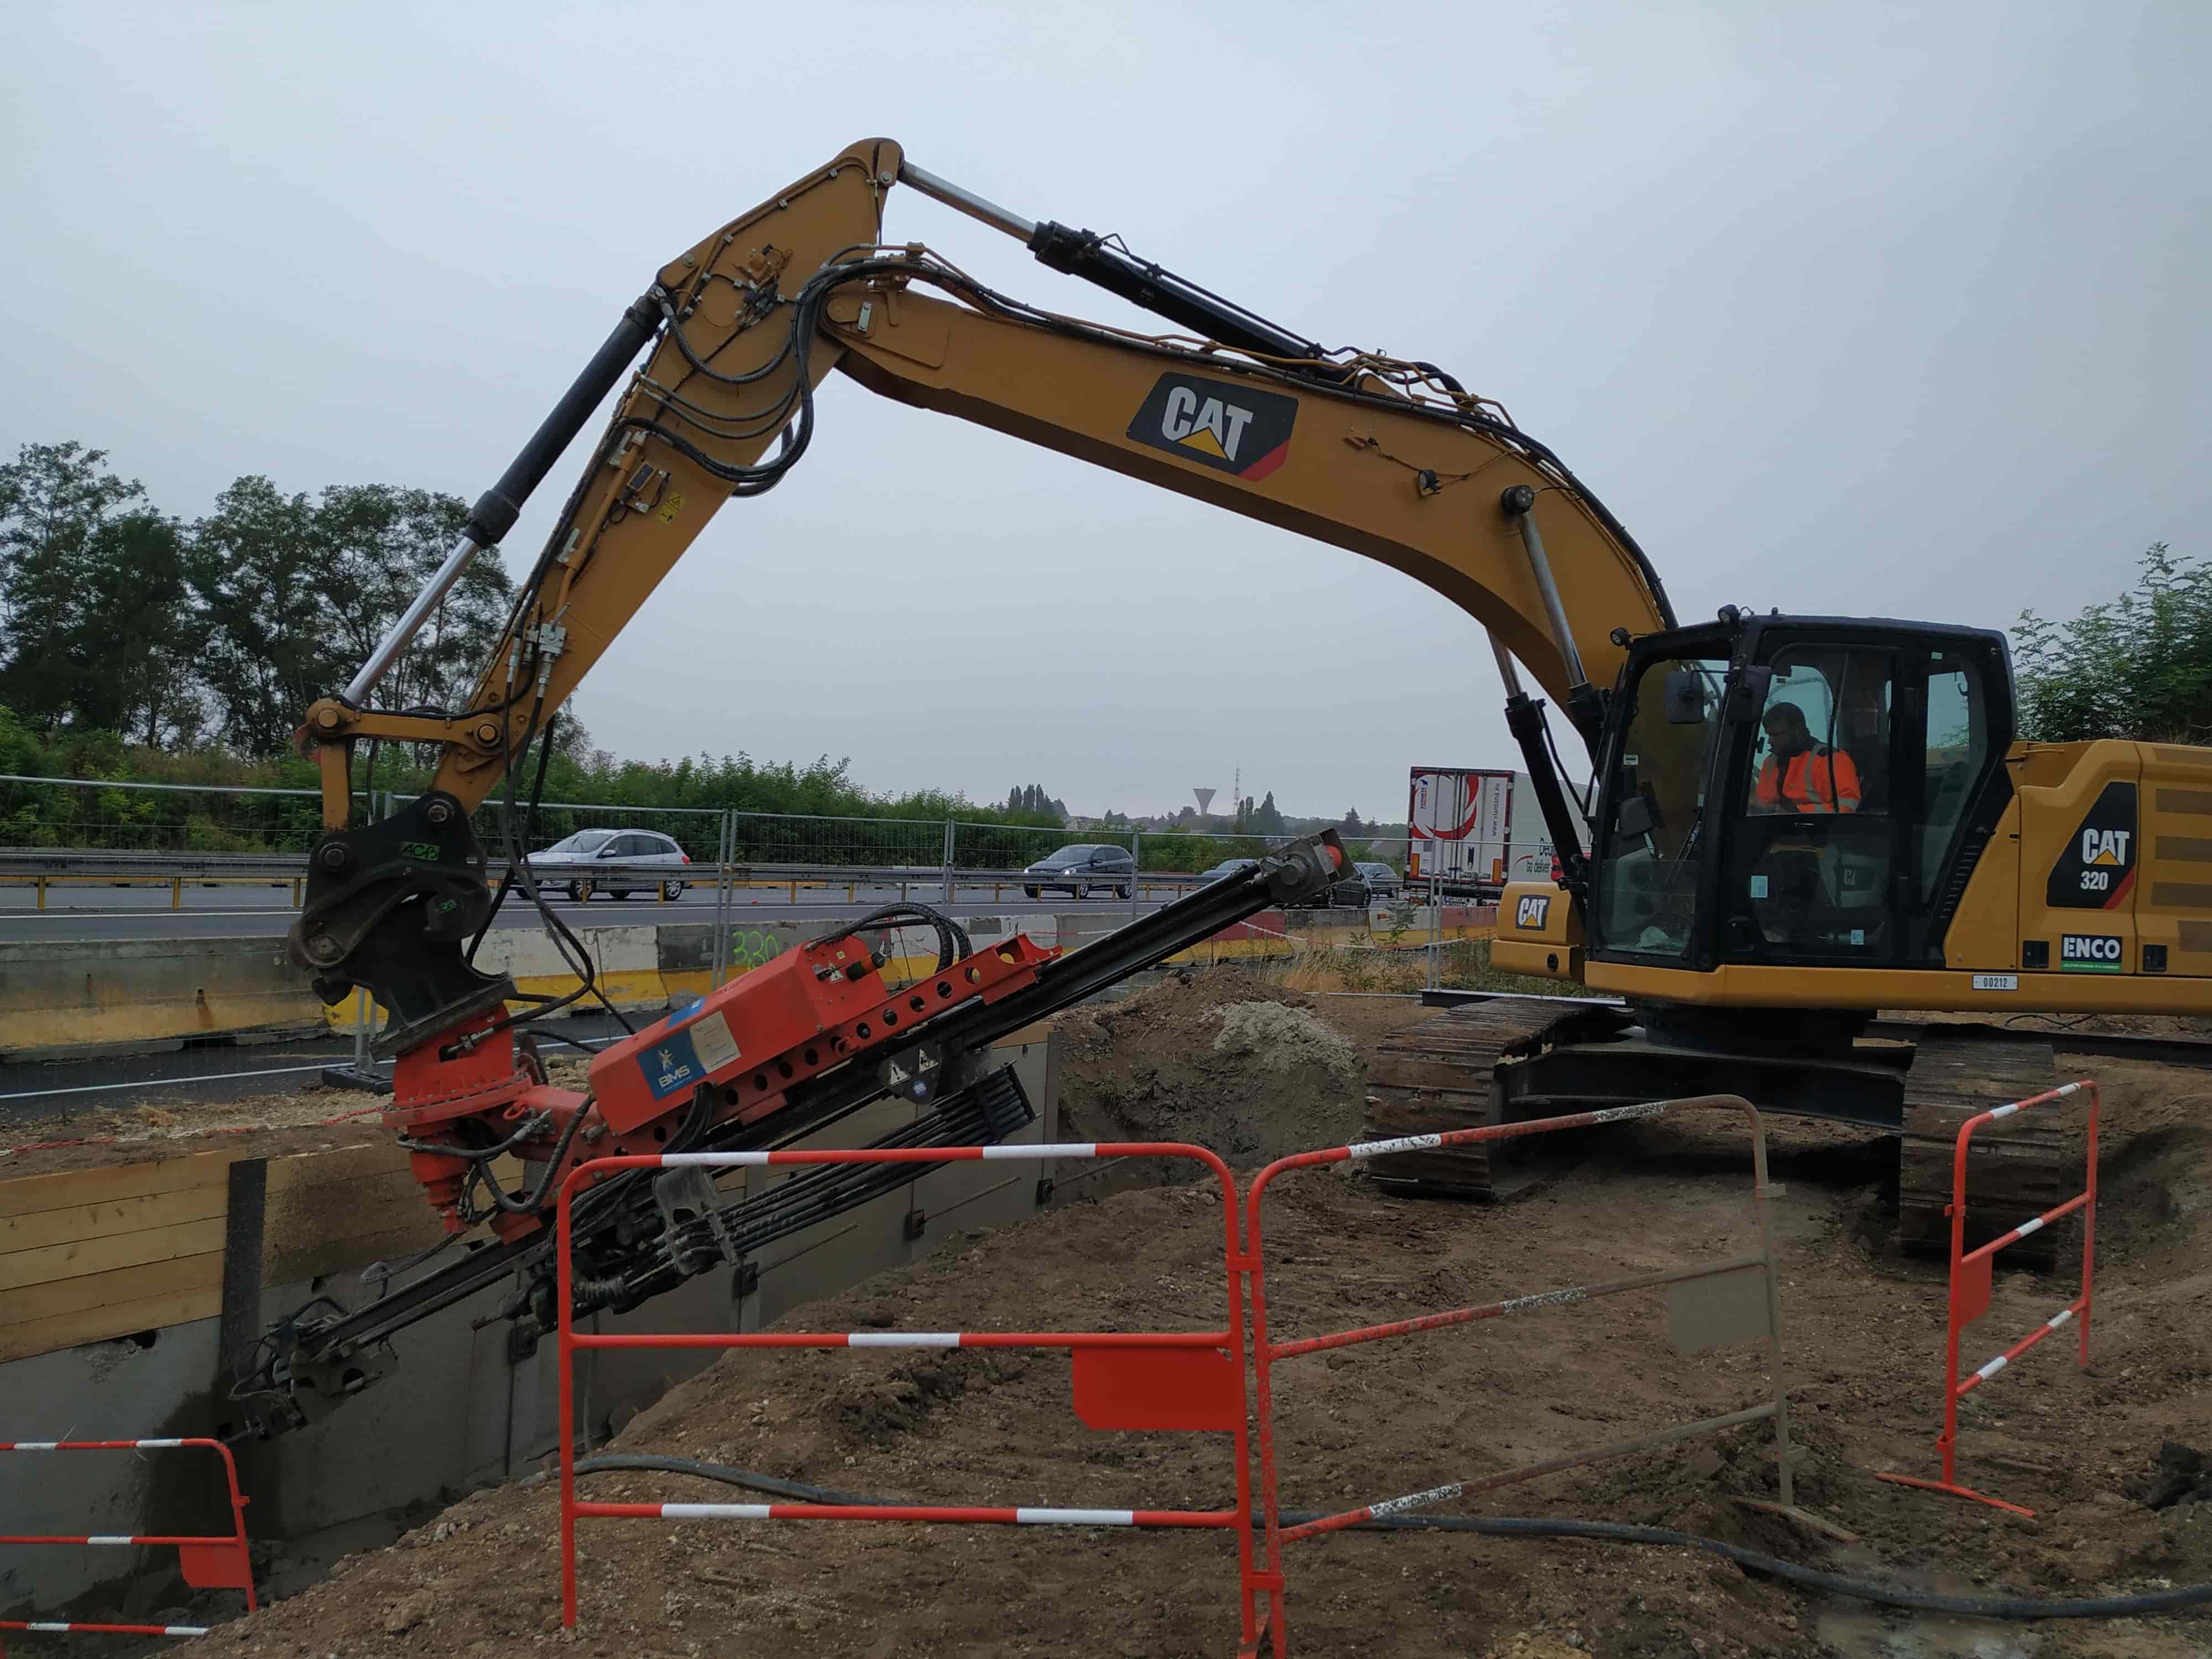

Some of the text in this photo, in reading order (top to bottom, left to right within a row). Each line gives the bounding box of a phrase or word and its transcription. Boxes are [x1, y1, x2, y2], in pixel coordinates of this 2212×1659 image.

[1162, 387, 1254, 461] CAT
[2082, 828, 2130, 866] CAT
[2080, 871, 2109, 890] 320
[1517, 898, 1547, 927] CAT
[2063, 937, 2121, 959] ENCO
[658, 1064, 691, 1088] BMS
